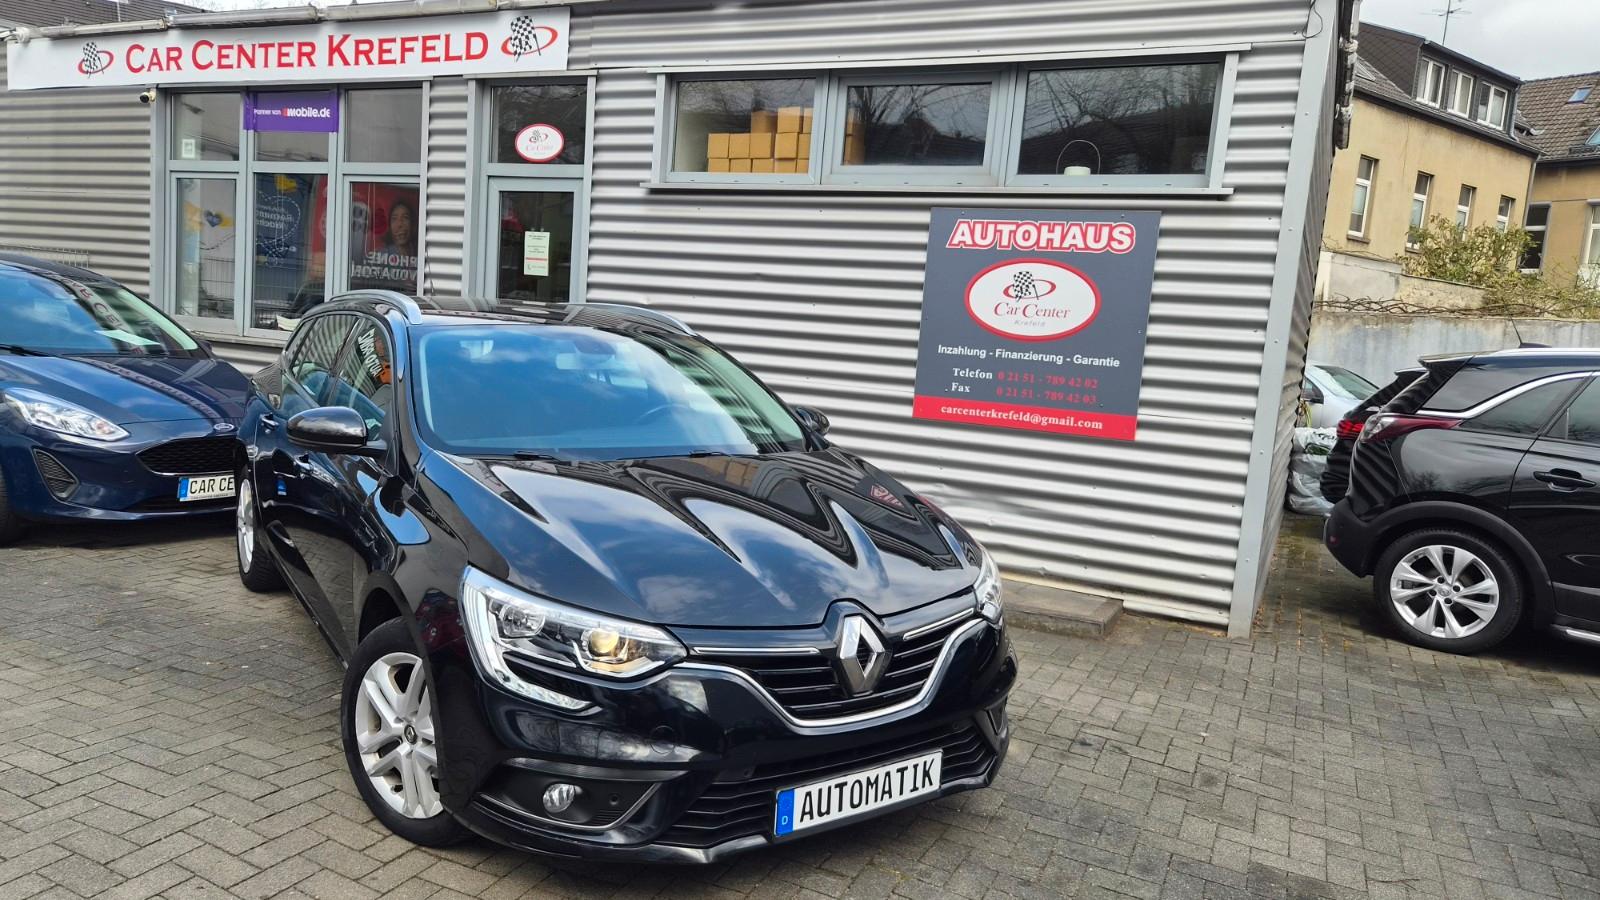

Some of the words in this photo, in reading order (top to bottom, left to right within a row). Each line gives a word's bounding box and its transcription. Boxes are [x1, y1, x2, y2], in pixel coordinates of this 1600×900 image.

[126, 44, 182, 73] CAR
[192, 40, 316, 70] CENTER
[327, 32, 489, 67] KREFELD
[946, 219, 1136, 254] AUTOHAUS
[994, 302, 1021, 317] Car
[1022, 303, 1071, 319] Center
[938, 344, 987, 359] Inzahlung
[995, 348, 1064, 365] Finanzierung
[1073, 354, 1120, 367] Garantie
[952, 367, 993, 380] Telefon
[997, 370, 1005, 381] 0
[1008, 371, 1019, 382] 21
[1023, 372, 1034, 384] 51
[1045, 375, 1066, 386] 789
[951, 382, 971, 393] Fax
[996, 386, 1004, 398] 0
[1044, 390, 1064, 401] 789
[941, 405, 1103, 430] carcenterkrefeld@gmail.com
[190, 479, 216, 494] CAR
[219, 476, 234, 492] CE
[781, 815, 789, 825] D
[799, 758, 935, 823] AUTOMATIK
